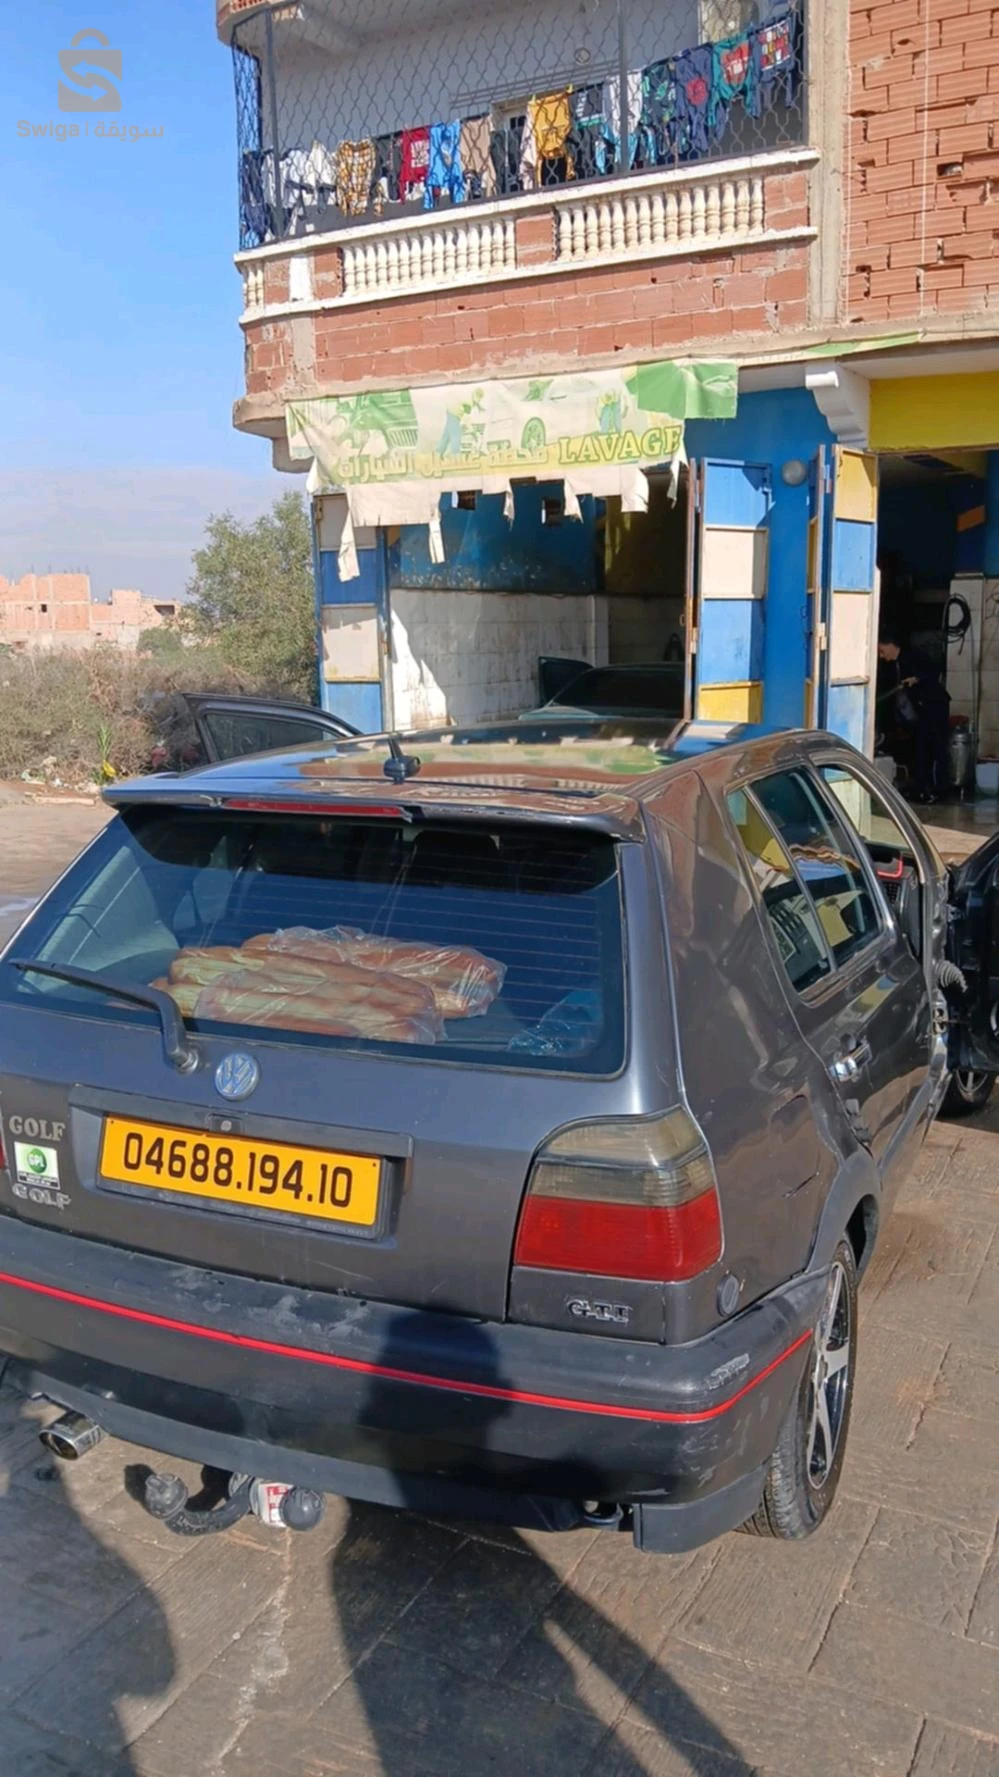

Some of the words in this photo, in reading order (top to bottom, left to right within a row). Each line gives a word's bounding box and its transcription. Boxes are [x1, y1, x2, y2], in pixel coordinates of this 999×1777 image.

[558, 424, 683, 465] LAVAGE
[8, 1115, 66, 1142] GOLF
[123, 1132, 353, 1209] 04688.194.10
